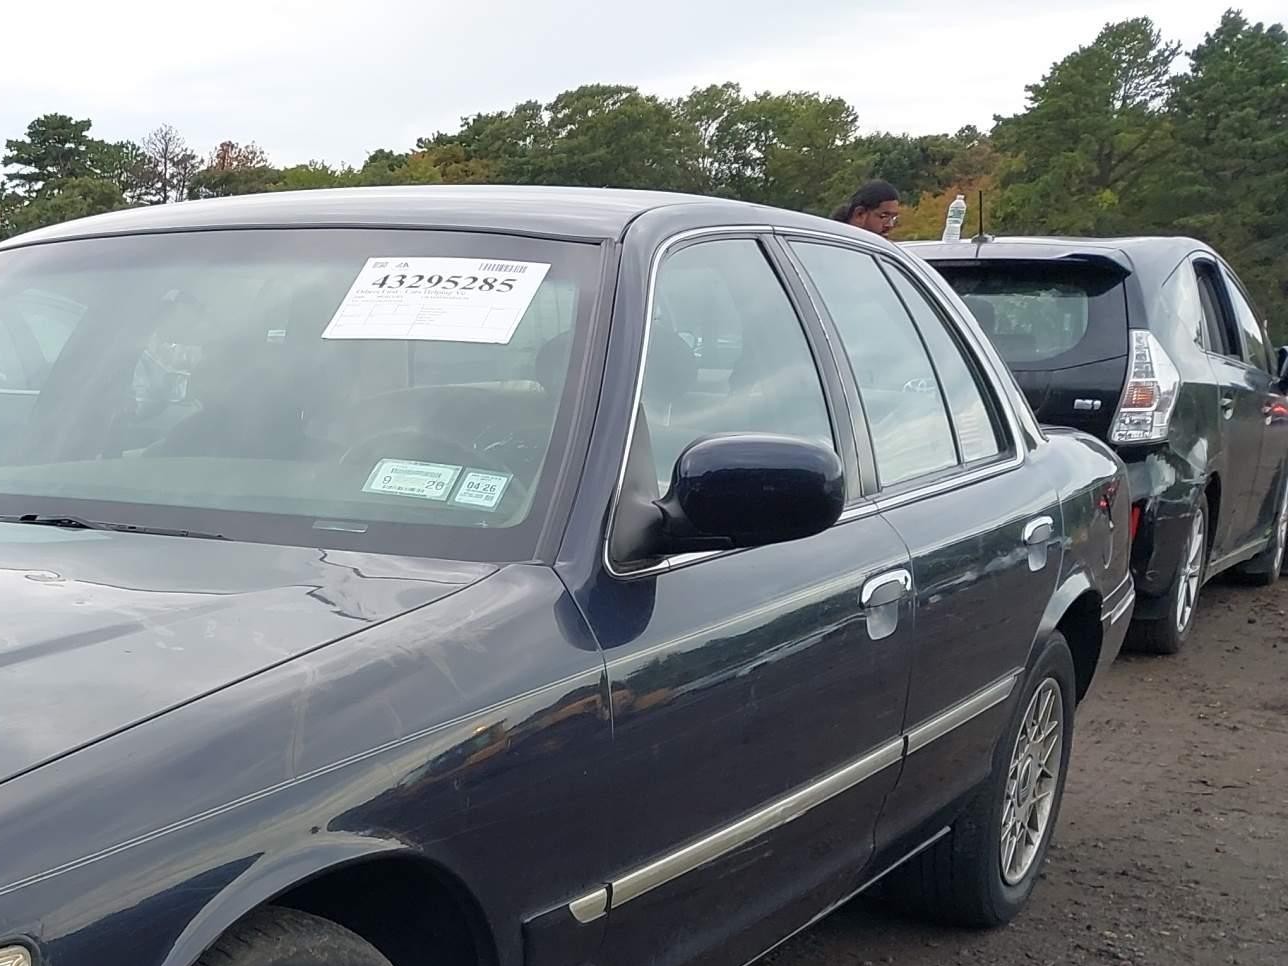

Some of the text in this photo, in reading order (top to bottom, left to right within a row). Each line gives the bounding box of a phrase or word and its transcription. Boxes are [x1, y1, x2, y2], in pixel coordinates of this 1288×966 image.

[371, 273, 517, 293] 43295285
[382, 475, 392, 485] 9
[425, 480, 445, 490] 26
[466, 481, 497, 493] 04 26
